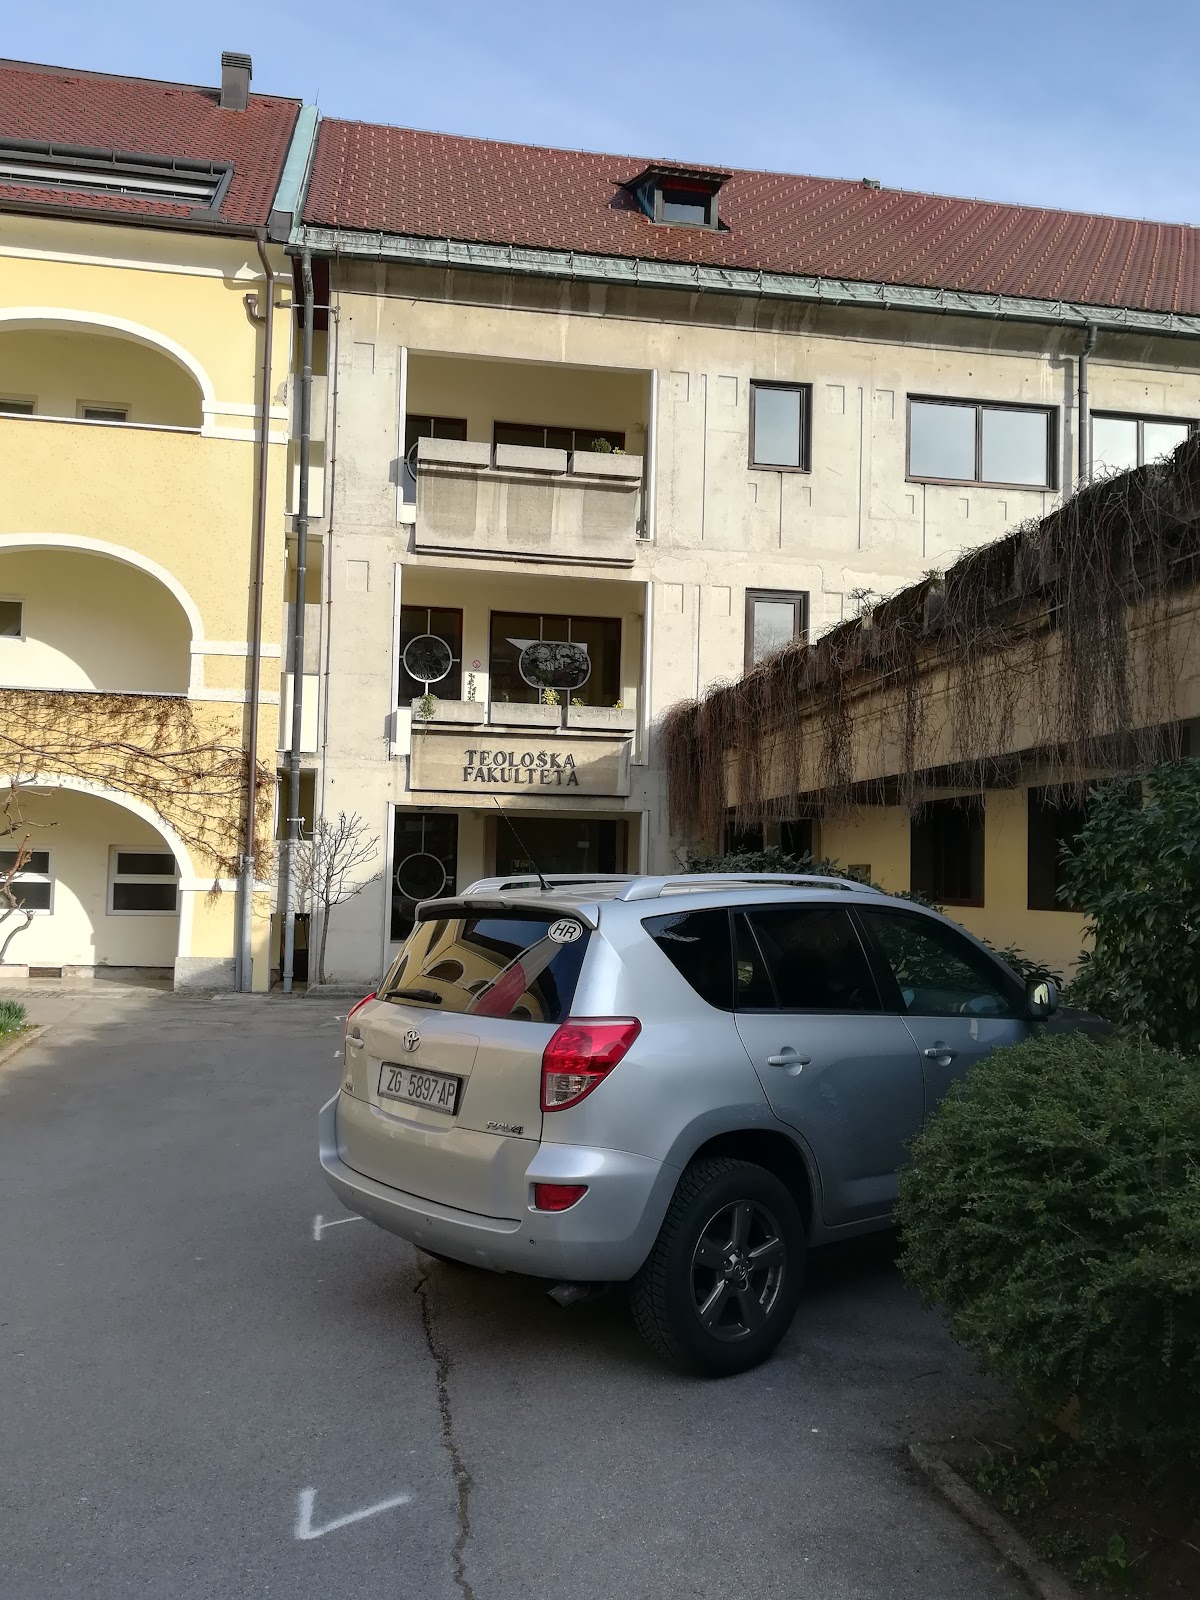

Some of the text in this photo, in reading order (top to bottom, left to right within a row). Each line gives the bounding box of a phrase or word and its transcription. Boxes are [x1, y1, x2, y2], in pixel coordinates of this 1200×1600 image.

[464, 749, 576, 769] TEOLOŠKA
[463, 766, 579, 786] FAKULTETA
[553, 923, 577, 939] HR
[387, 1069, 402, 1093] ZG
[486, 1120, 524, 1135] RAV4
